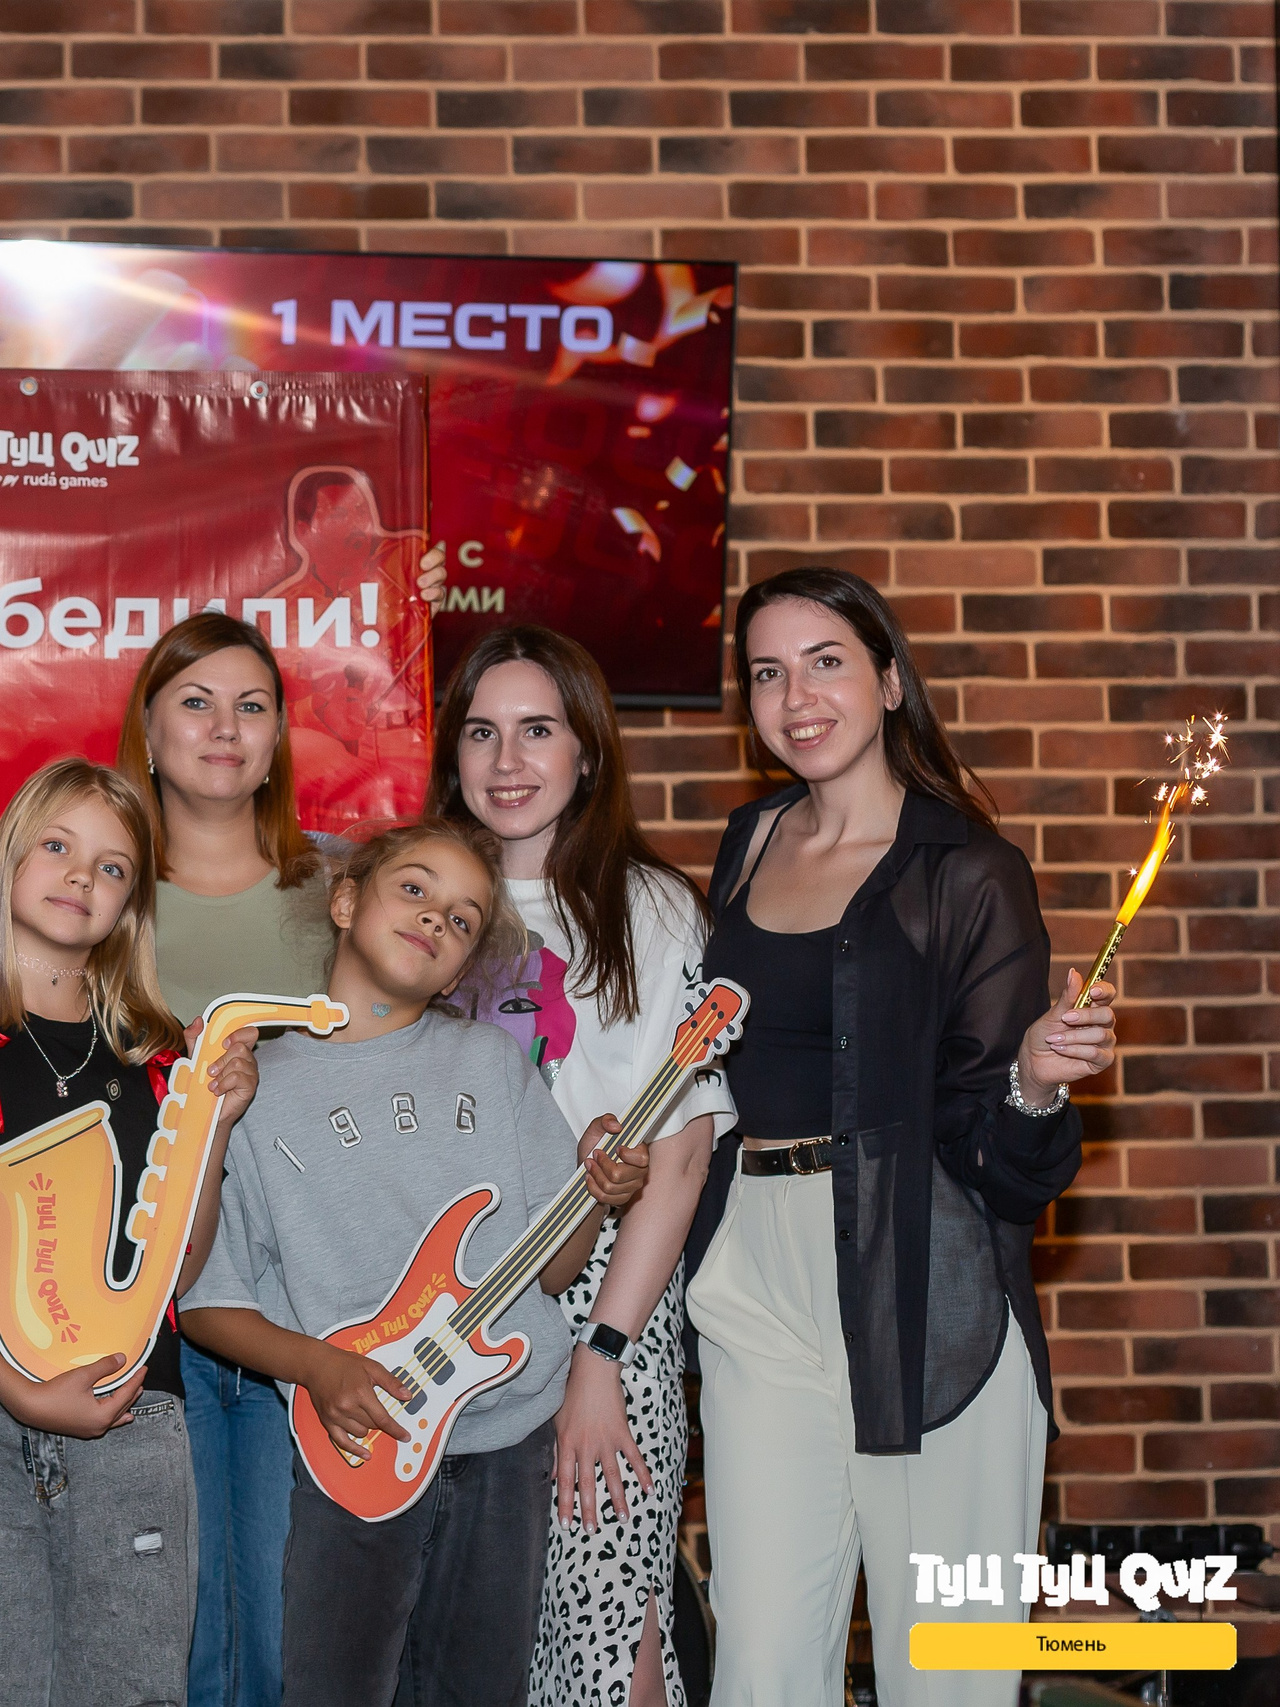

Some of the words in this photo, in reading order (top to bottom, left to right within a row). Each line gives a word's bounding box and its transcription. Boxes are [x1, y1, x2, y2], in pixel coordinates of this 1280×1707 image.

[271, 298, 298, 346] 1
[330, 299, 615, 353] МЕСТО
[59, 474, 109, 490] games
[272, 1091, 478, 1174] 1986
